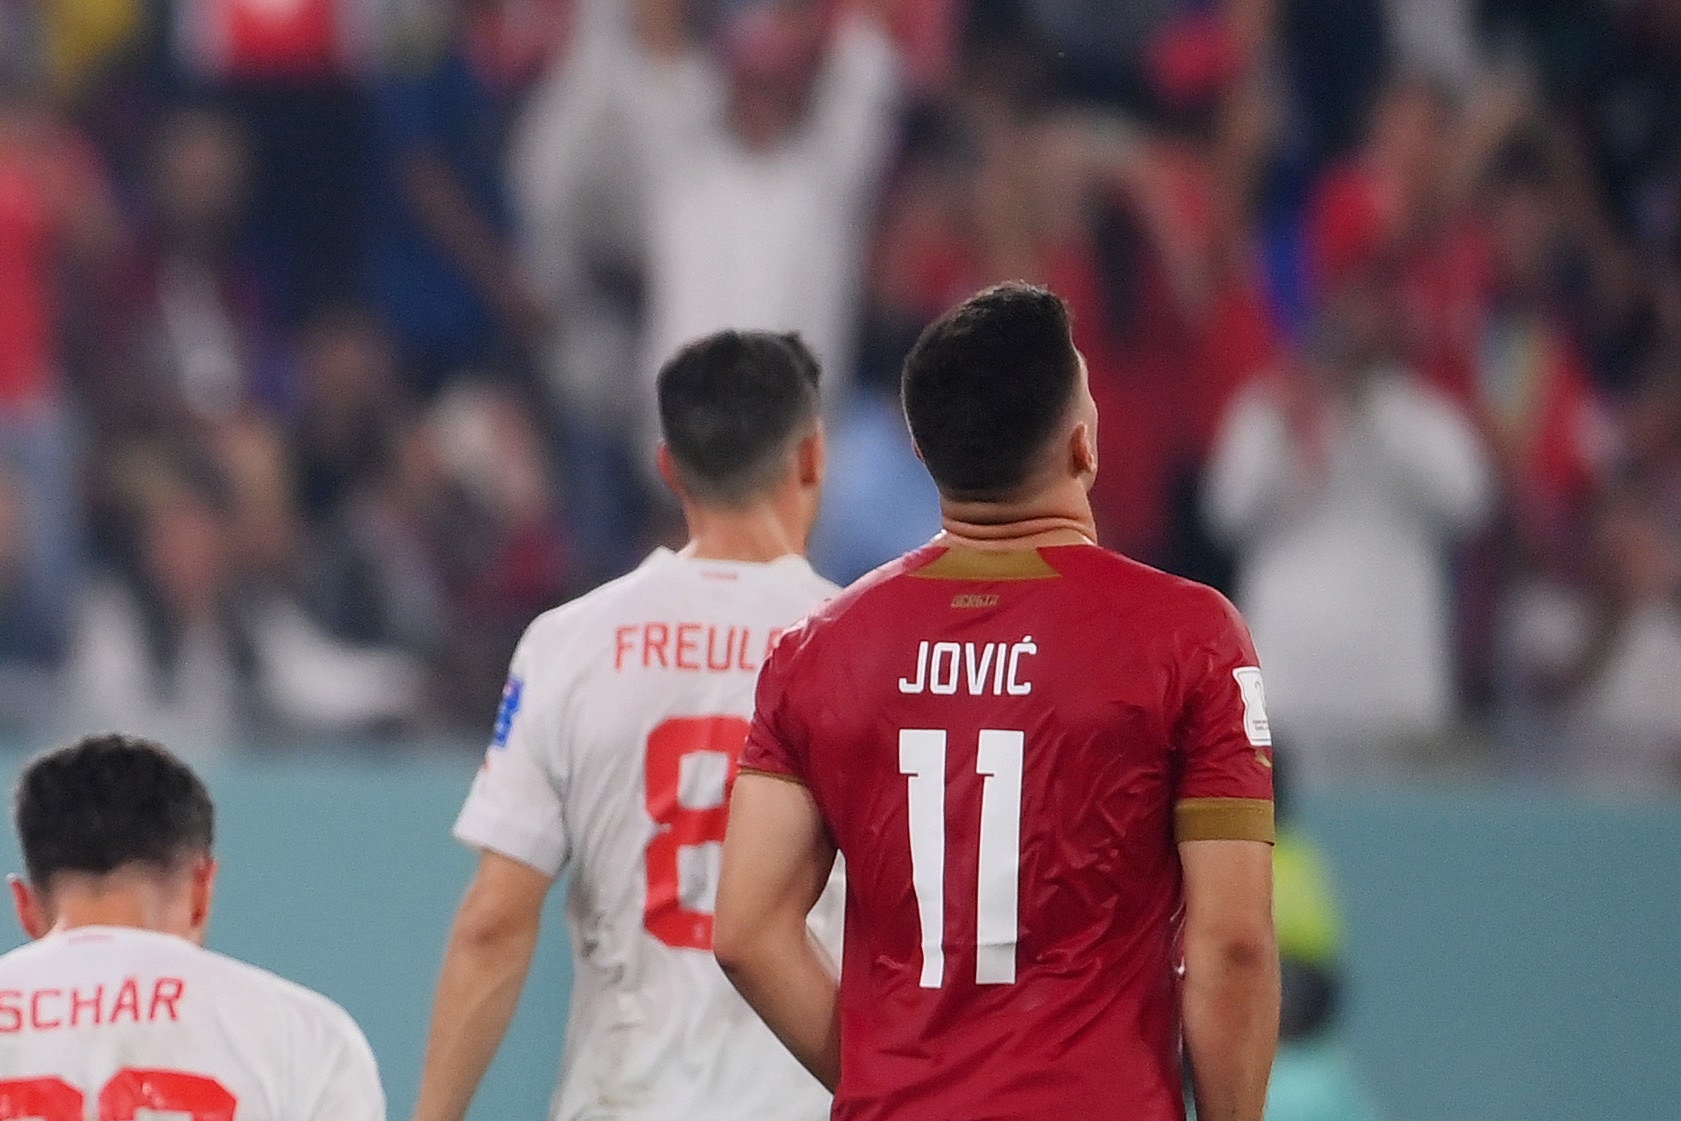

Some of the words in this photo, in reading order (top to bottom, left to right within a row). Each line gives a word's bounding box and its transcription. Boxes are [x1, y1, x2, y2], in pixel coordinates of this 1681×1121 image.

[898, 635, 1037, 695] JOVIĆ
[643, 714, 750, 951] 8
[898, 729, 1024, 988] 11
